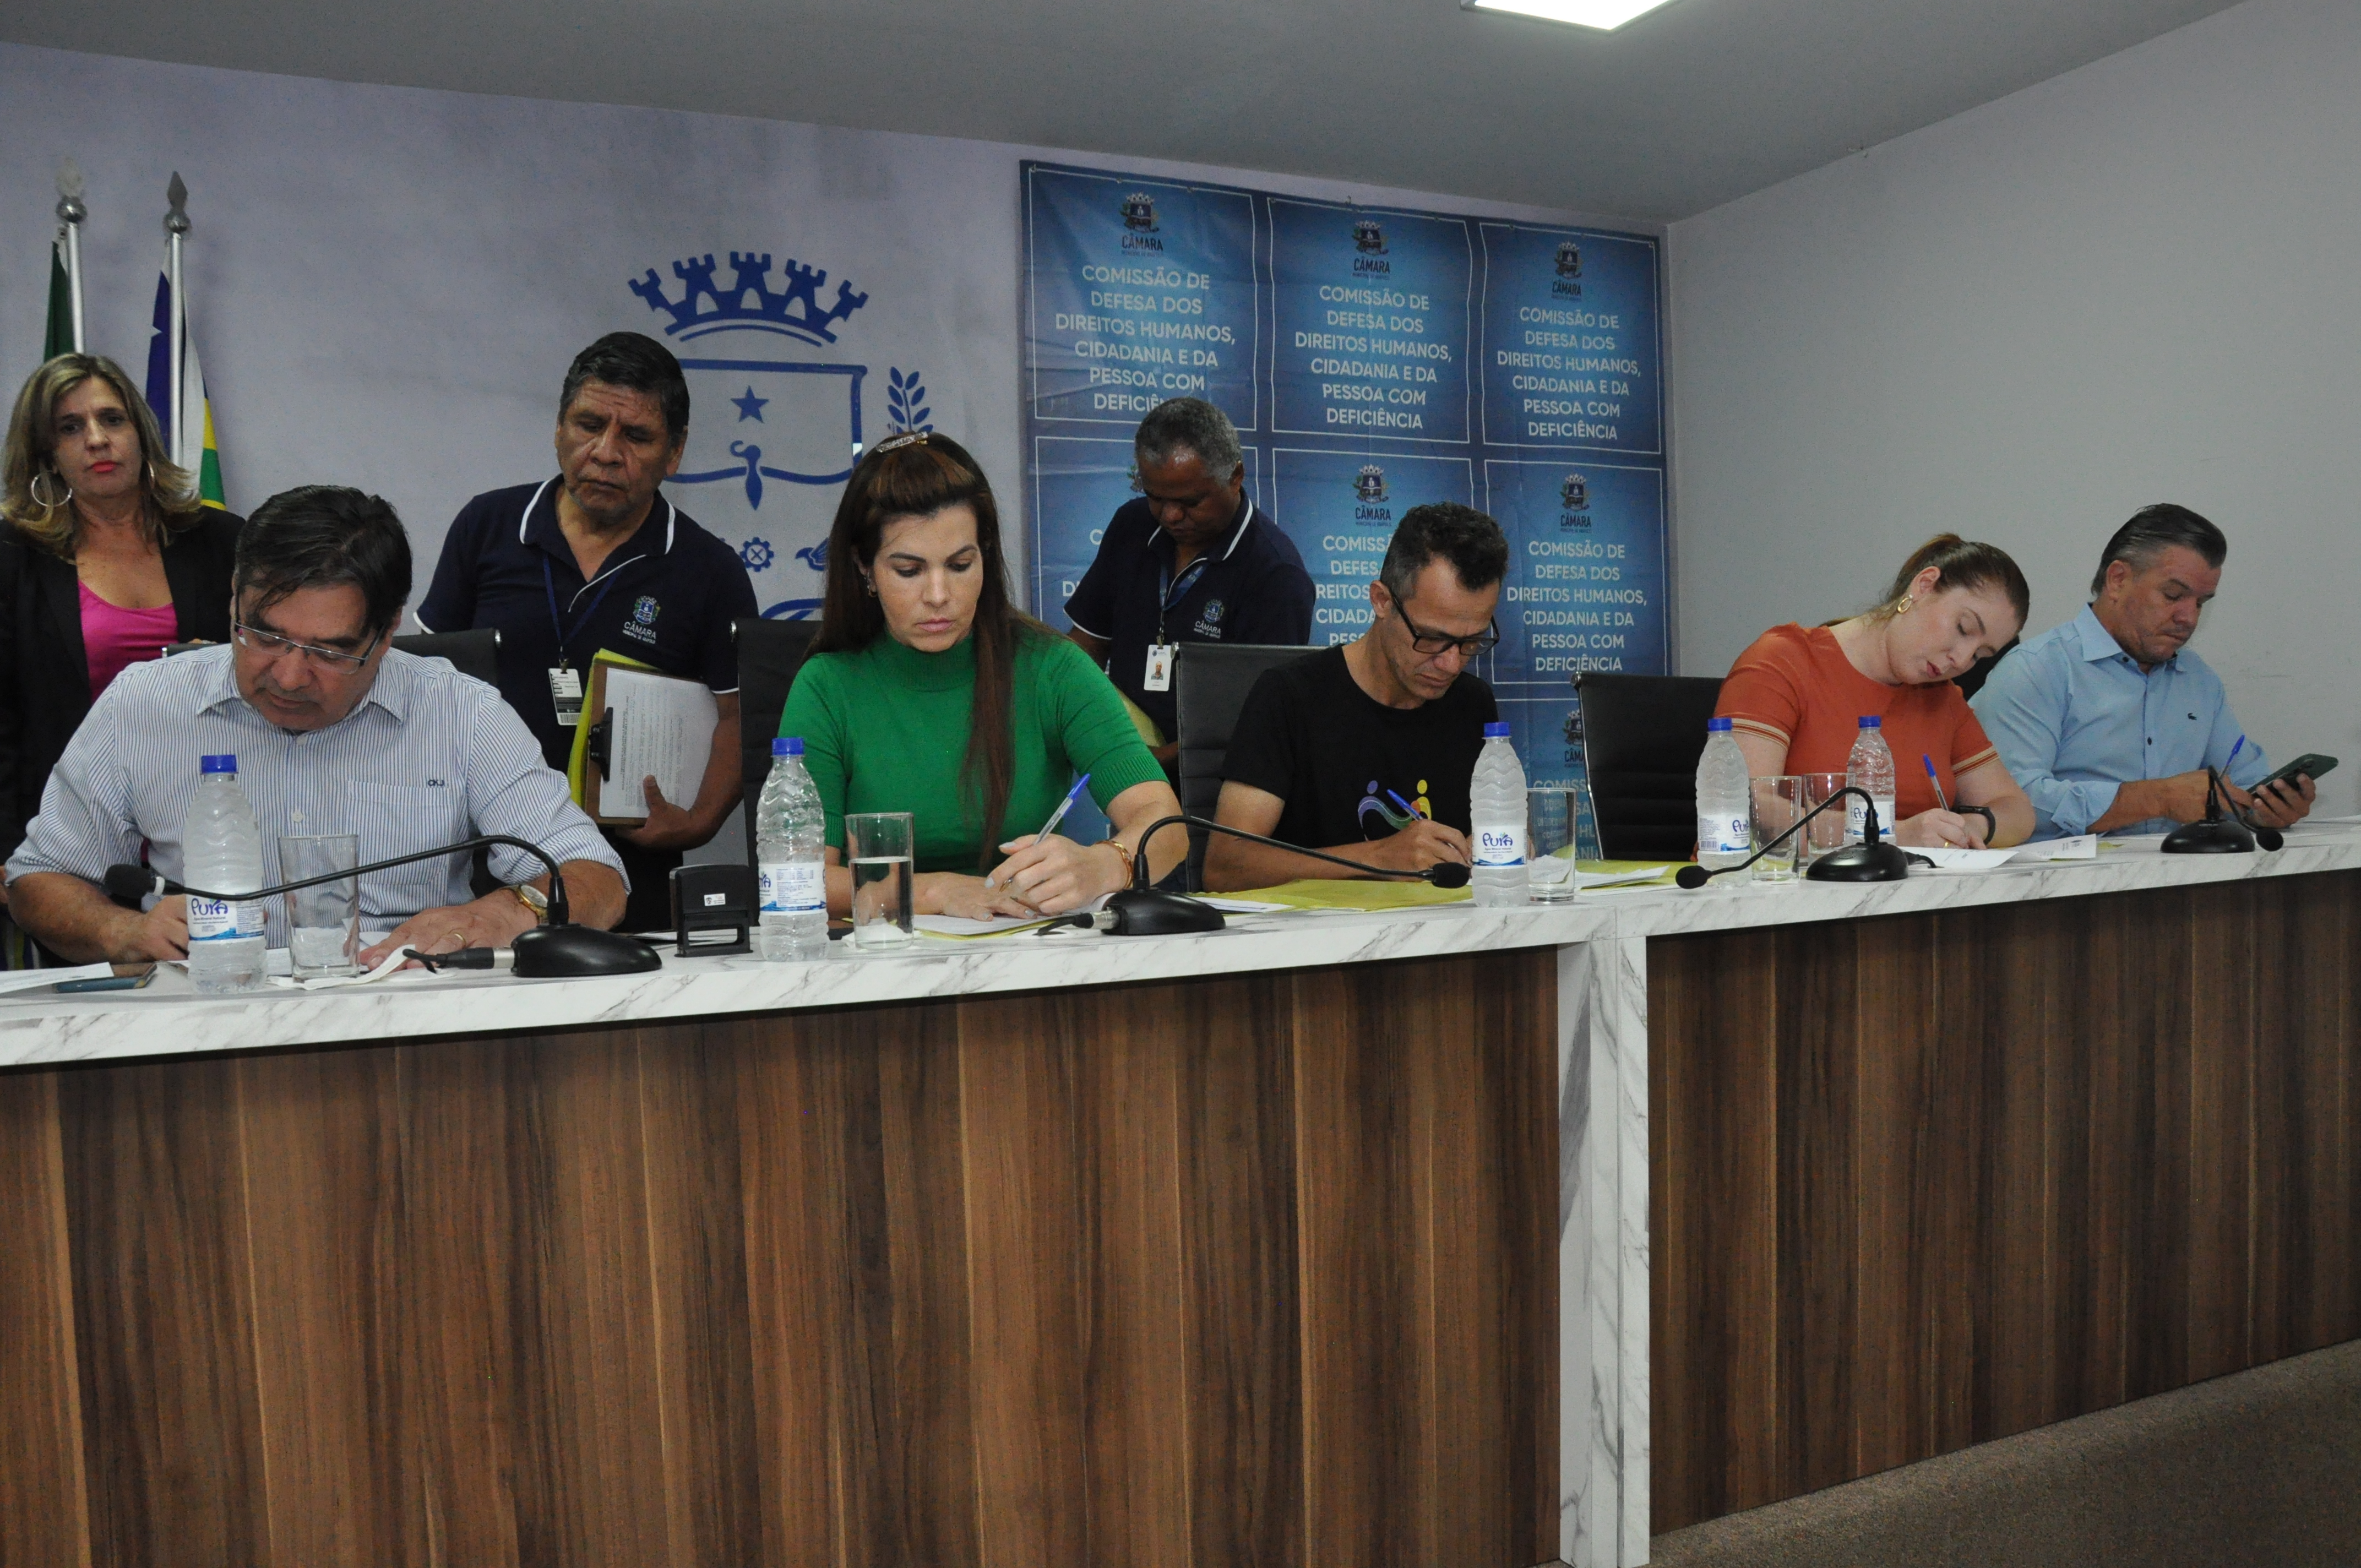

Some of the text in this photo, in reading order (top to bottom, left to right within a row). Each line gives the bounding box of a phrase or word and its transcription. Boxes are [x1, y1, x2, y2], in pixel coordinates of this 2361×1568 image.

[1122, 234, 1163, 251] CÂMARA
[1354, 257, 1390, 274] CÂMARA
[1083, 266, 1209, 290] COMISSÃO DE
[1552, 280, 1581, 296] CÂMARA
[1092, 292, 1202, 314] DEFESA DOS
[1320, 286, 1429, 310] COMISSÃO DE
[1328, 311, 1423, 333] DEFESA DOS
[1520, 307, 1619, 328] COMISSÃO DE
[1056, 313, 1235, 345] DIREITOS HUMANOS,
[1296, 332, 1451, 362] DIREITOS HUMANOS,
[1526, 330, 1615, 350] DEFESA DOS
[1075, 339, 1218, 366] CIDADANIA E DA
[1311, 358, 1437, 382] CIDADANIA E DA
[1498, 351, 1640, 376] DIREITOS HUMANOS,
[1089, 368, 1204, 390] PESSOA COM
[1513, 375, 1629, 395] CIDADANIA E DA
[1094, 393, 1165, 412] DEFICIÊ
[1323, 384, 1426, 405] PESSOA COM
[1327, 407, 1422, 428] DEFICIÊNCIA
[1524, 399, 1619, 417] PESSOA COM
[1528, 420, 1617, 439] DEFICIÊNCIA
[1356, 505, 1391, 520] CÂMARA
[1560, 513, 1591, 528] CÂMARA
[1323, 533, 1393, 552] COMISS
[1528, 540, 1624, 558] COMISSÃO DE
[1536, 565, 1619, 580] DEFESA DOS
[1316, 584, 1370, 600] REITOS
[1508, 587, 1646, 605] DIREITOS HUMANOS,
[1316, 608, 1376, 624] CIDADA
[1524, 611, 1634, 626] CIDADANIA E DA
[624, 620, 656, 640] CÂMARA
[1195, 620, 1221, 635] CÂMARA
[1533, 634, 1624, 649] PESSOA COM
[1536, 654, 1622, 671] DEFICIÊNCIA
[1564, 749, 1585, 763] CÂMA
[1533, 778, 1587, 793] COMISS
